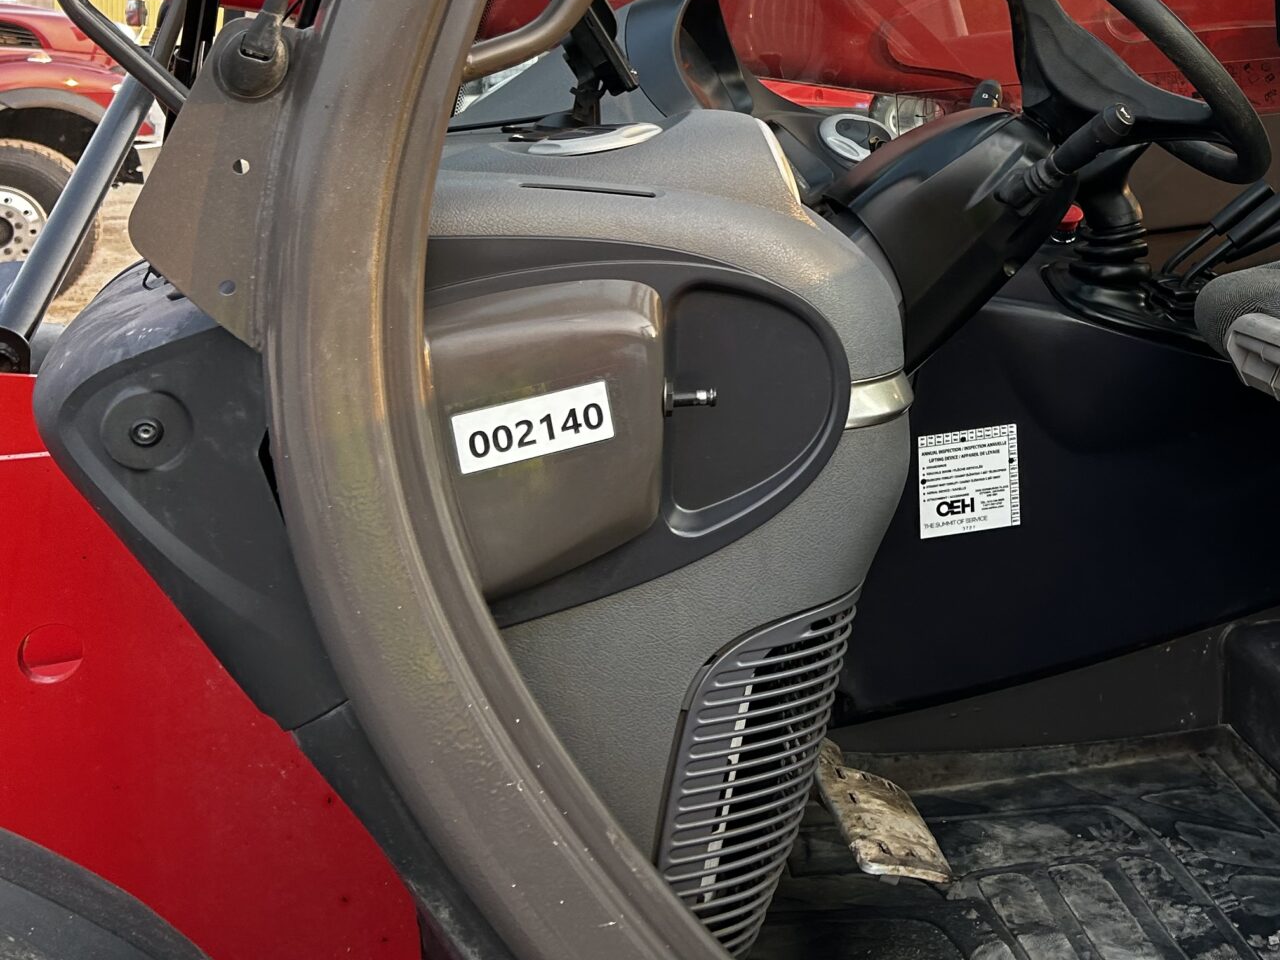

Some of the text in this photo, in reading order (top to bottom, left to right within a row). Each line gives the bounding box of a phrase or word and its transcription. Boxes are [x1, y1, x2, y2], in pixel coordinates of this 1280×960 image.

[468, 402, 604, 459] 002140
[936, 497, 975, 517] OEH
[935, 520, 956, 528] SUMMIT
[965, 515, 988, 524] SERVICE
